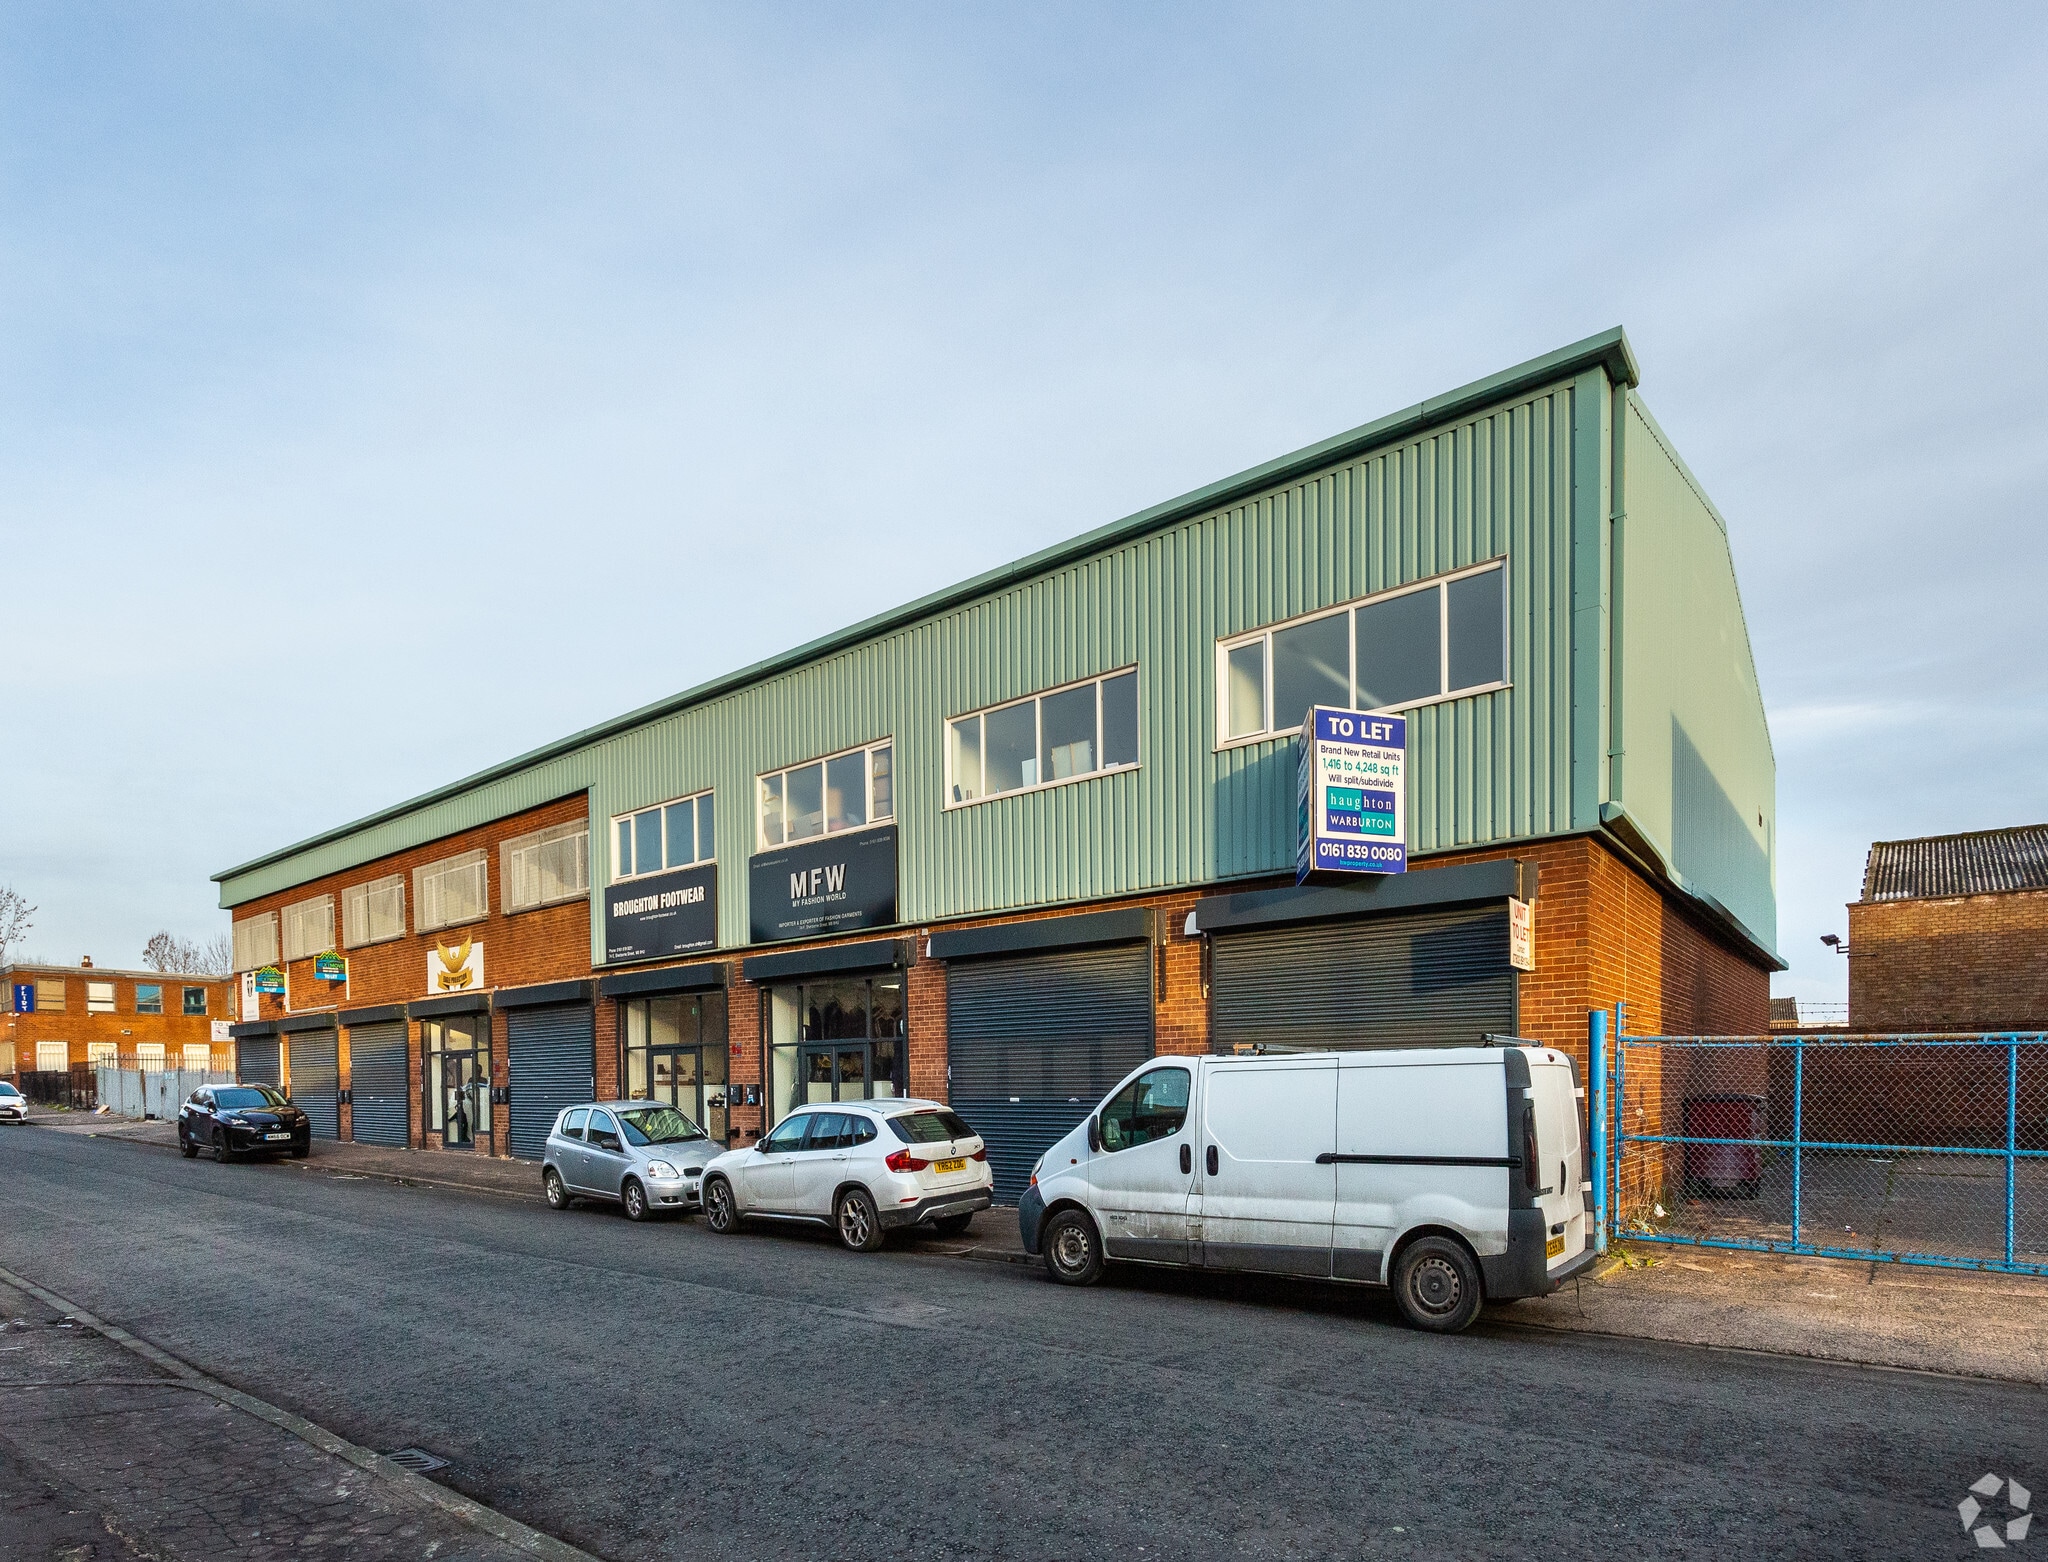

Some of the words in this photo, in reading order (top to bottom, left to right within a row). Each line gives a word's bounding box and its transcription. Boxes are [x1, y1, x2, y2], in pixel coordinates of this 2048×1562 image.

[1328, 717, 1354, 737] TO
[1361, 721, 1393, 740] LET
[1321, 745, 1341, 755] Brand
[1344, 747, 1360, 757] New
[1362, 749, 1380, 759] Retail
[1383, 752, 1400, 761] Units
[1323, 758, 1341, 771] 1,416
[1344, 761, 1352, 771] to
[1355, 761, 1378, 774] 4,248
[1380, 766, 1389, 776] sq
[1392, 765, 1398, 775] ft
[1328, 774, 1342, 783] Will
[1344, 775, 1394, 788] split/subdivide
[1330, 793, 1392, 810] haughton
[1330, 815, 1392, 829] WARBURTON
[1320, 843, 1344, 857] 0161
[1347, 845, 1368, 859] 839
[1371, 847, 1402, 861] 0080
[1340, 860, 1383, 868] hwproperty.co.uk
[790, 863, 846, 899] MFW
[613, 895, 658, 917] BROUGHTON
[660, 886, 705, 909] FOOTWEAR
[792, 900, 800, 908] MY
[802, 895, 824, 906] FASHION
[826, 892, 847, 902] WORLD
[1514, 903, 1526, 922] UNIT
[779, 920, 796, 928] IMPORTER
[800, 917, 818, 925] EXPORTER
[1512, 922, 1519, 939] TO
[1520, 926, 1530, 943] LET
